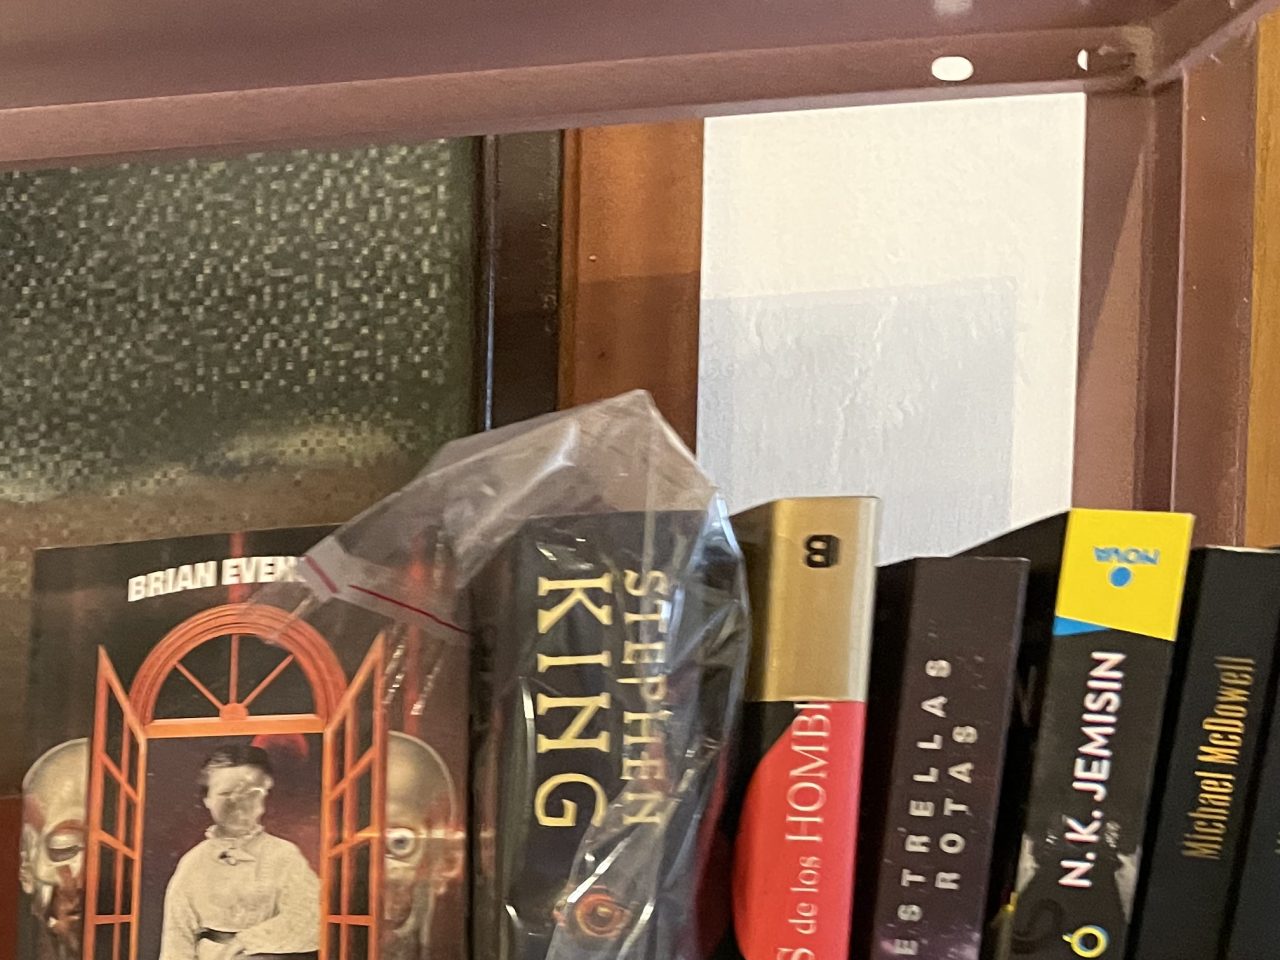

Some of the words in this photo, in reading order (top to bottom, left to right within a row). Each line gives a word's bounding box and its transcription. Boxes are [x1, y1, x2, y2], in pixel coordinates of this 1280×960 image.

[128, 560, 217, 601] BRIAN
[1094, 546, 1160, 565] NOVA
[534, 572, 613, 827] KING
[616, 569, 673, 826] STEPHEN
[1071, 651, 1126, 802] JEMISIN
[1196, 655, 1256, 765] McDowell
[785, 702, 832, 842] HOMB
[893, 659, 952, 956] ESTRELLAS
[934, 725, 978, 890] ROTAS
[1181, 769, 1236, 860] Michael
[789, 856, 821, 892] los
[1058, 852, 1097, 889] N.
[1062, 809, 1103, 842] K.
[788, 902, 817, 935] de
